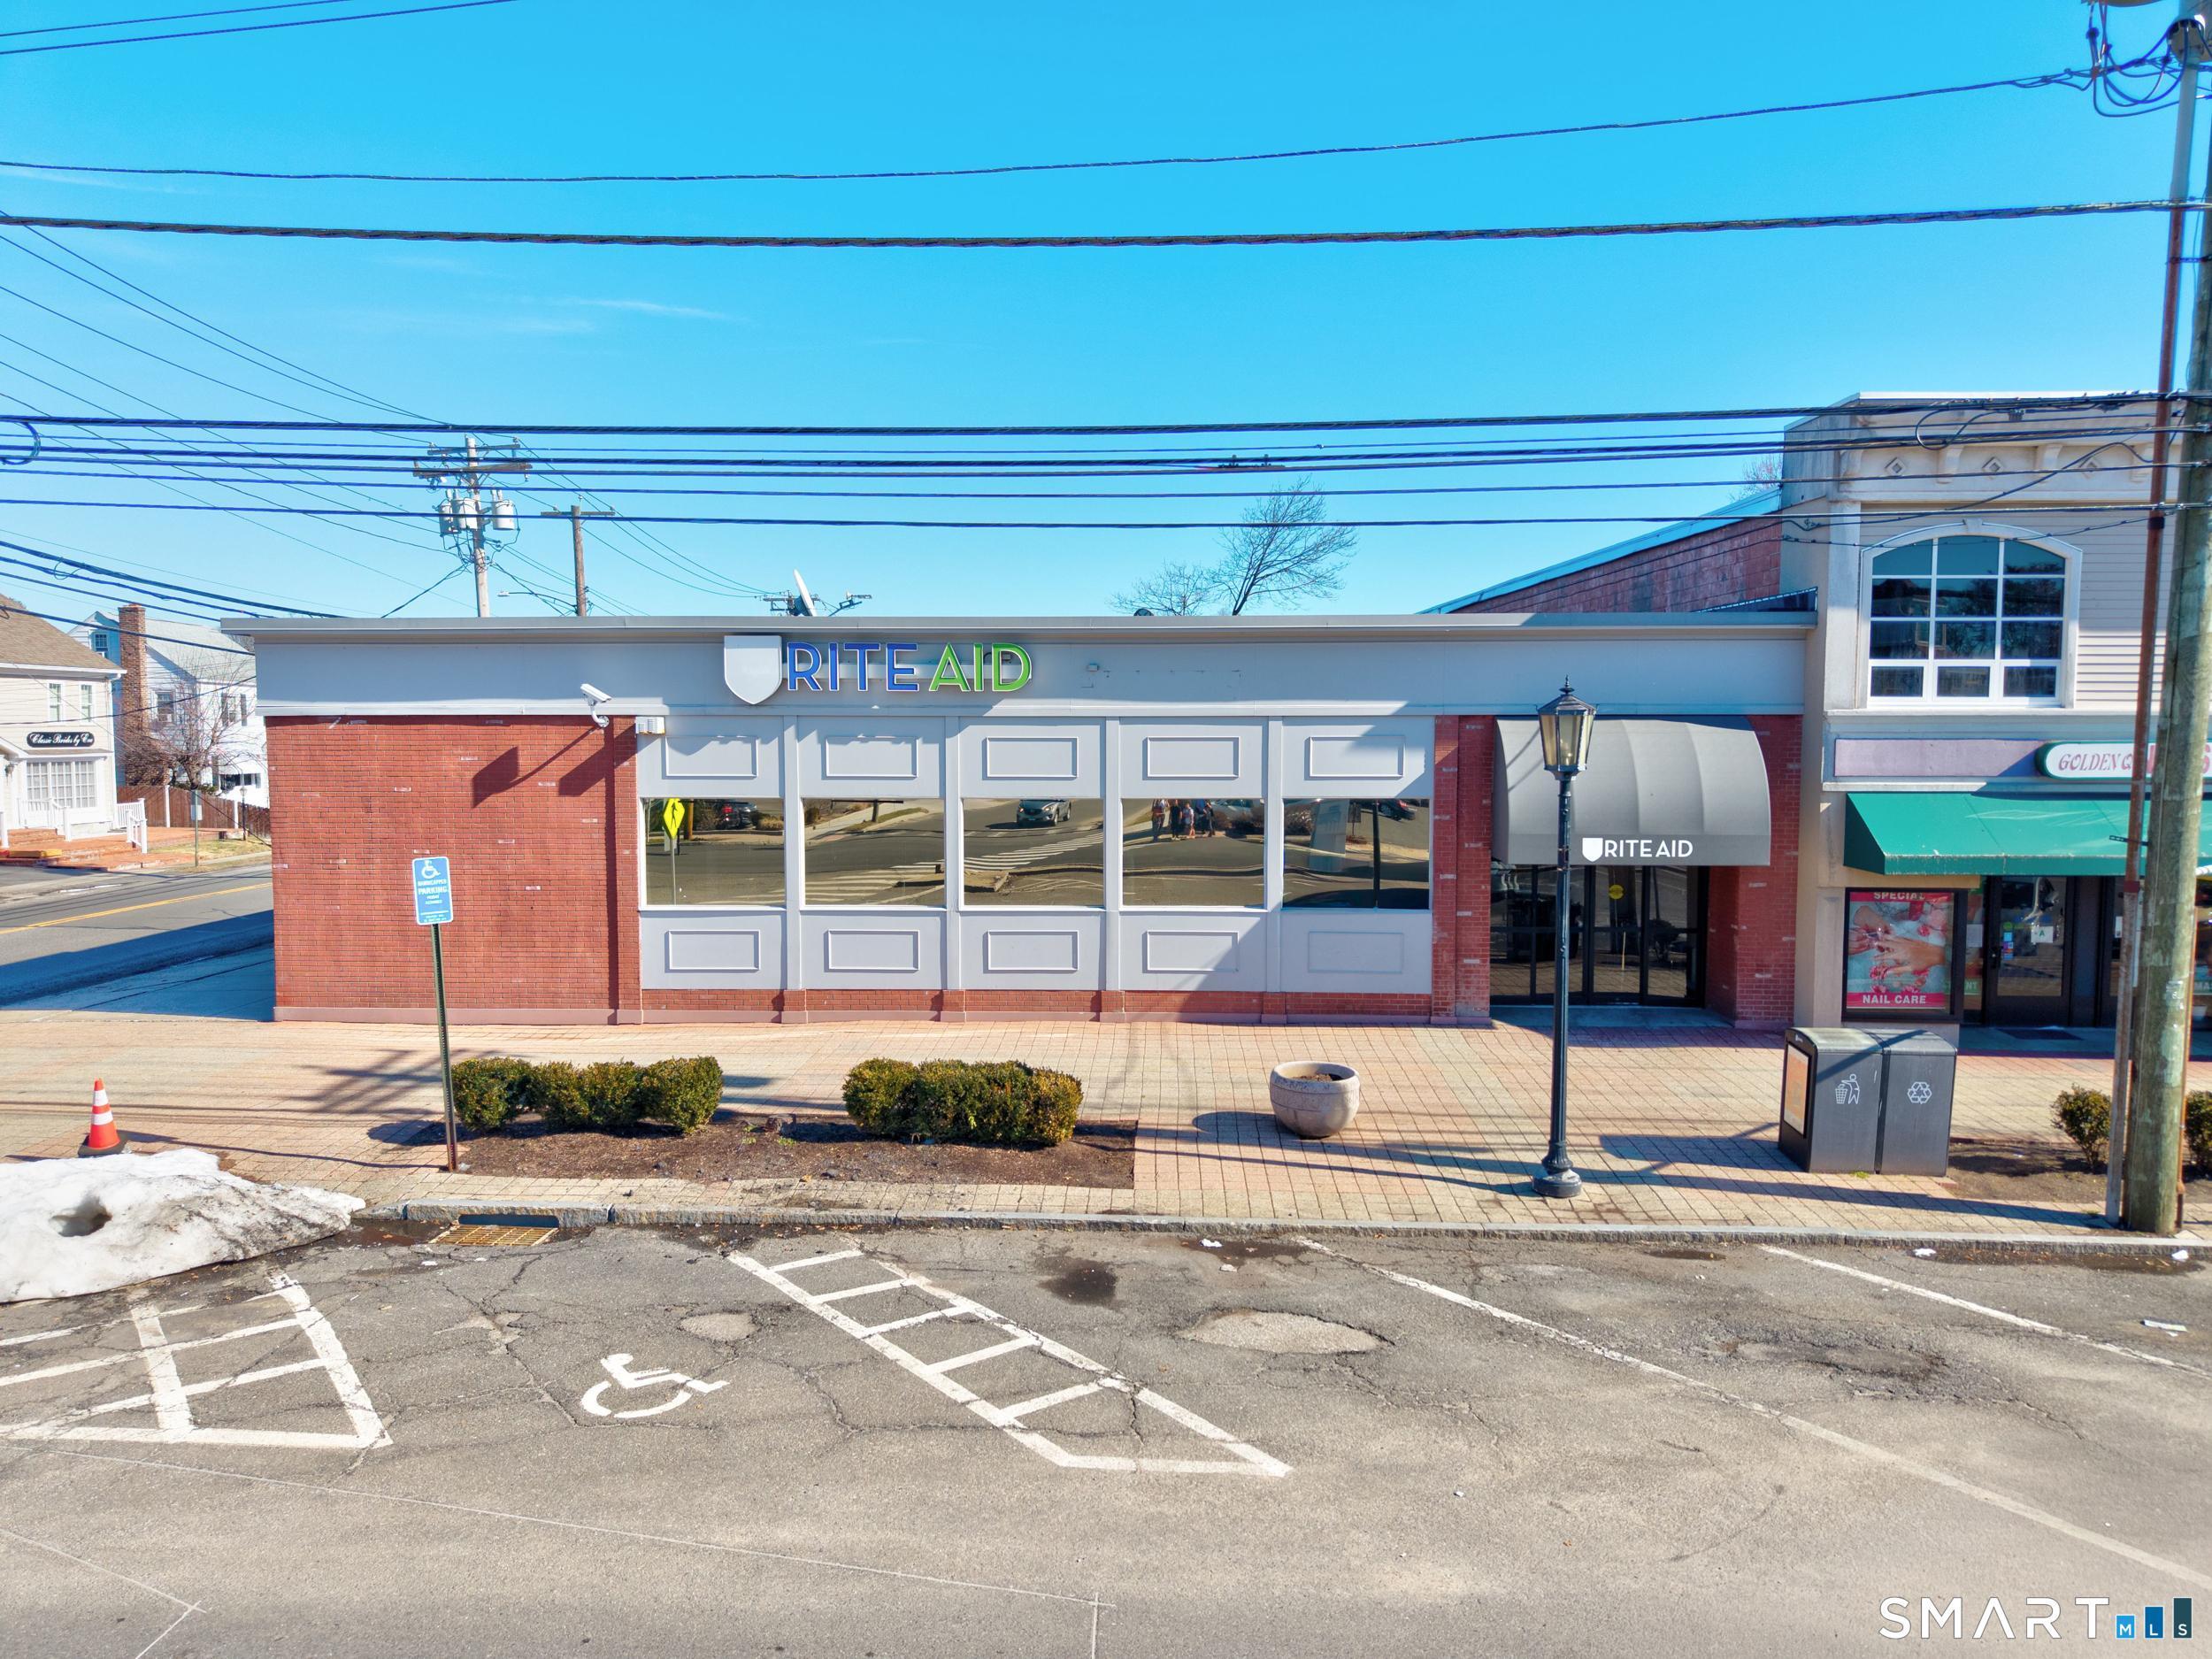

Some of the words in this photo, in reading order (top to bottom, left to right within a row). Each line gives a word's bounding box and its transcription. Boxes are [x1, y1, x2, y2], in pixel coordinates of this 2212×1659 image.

[787, 642, 919, 692] RITE
[929, 642, 1033, 692] AID
[53, 733, 72, 744] Brides
[73, 735, 81, 747] by
[2058, 753, 2120, 772] GOLDEN
[1604, 840, 1652, 857] RITE
[1655, 840, 1693, 857] AID
[1863, 995, 1890, 1004] NAIL
[1894, 995, 1926, 1004] CARE
